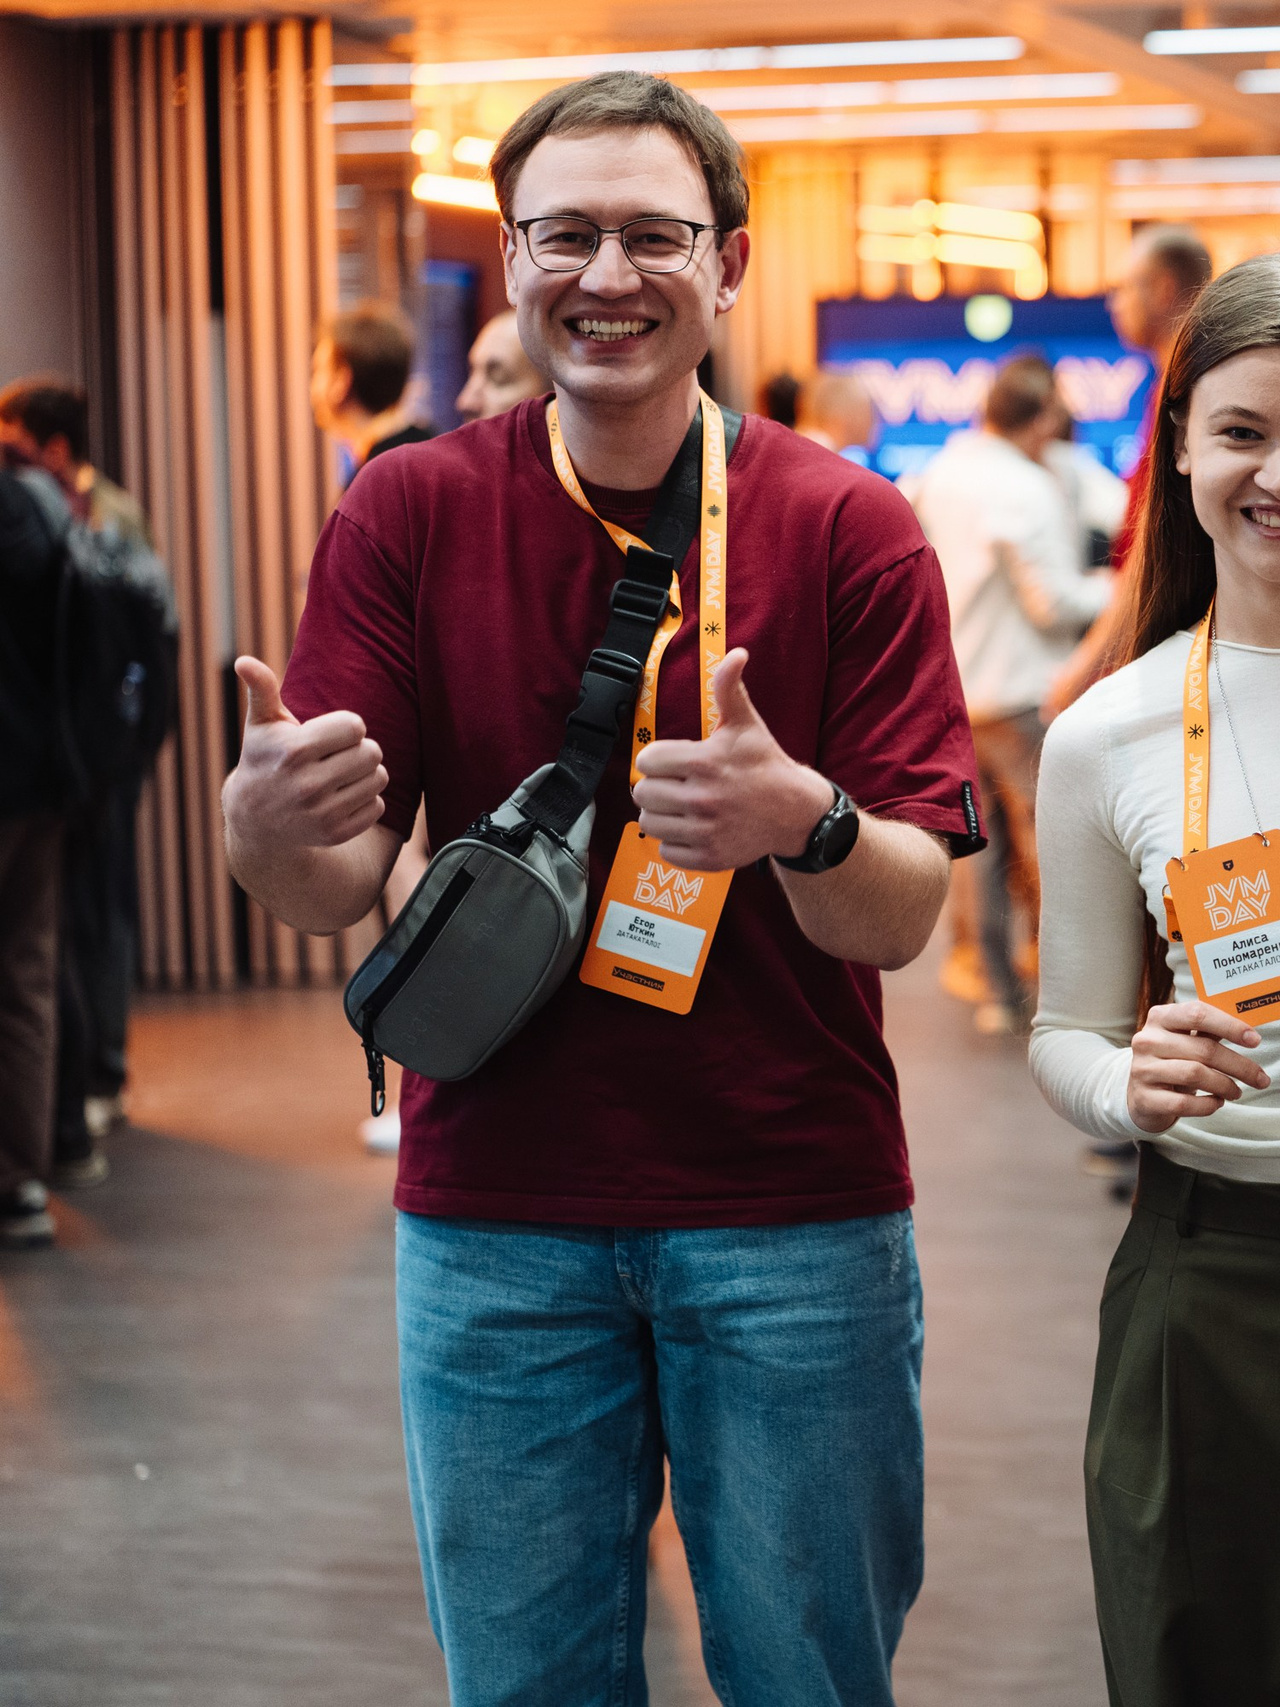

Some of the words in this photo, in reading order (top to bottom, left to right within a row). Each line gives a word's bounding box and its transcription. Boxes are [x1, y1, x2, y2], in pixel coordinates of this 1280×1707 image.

[706, 528, 721, 566] DAY
[706, 568, 721, 610] JVM
[1188, 672, 1202, 712] DAY
[1188, 753, 1203, 794] JVM
[1188, 796, 1202, 836] DAY
[633, 880, 697, 916] DAY
[637, 861, 704, 898] JVM
[1203, 869, 1270, 909] JVM
[634, 916, 655, 930] Егор
[1208, 892, 1271, 931] DAY
[628, 924, 655, 939] Юткин
[1232, 933, 1269, 952] Алиса
[613, 967, 664, 991] Участник
